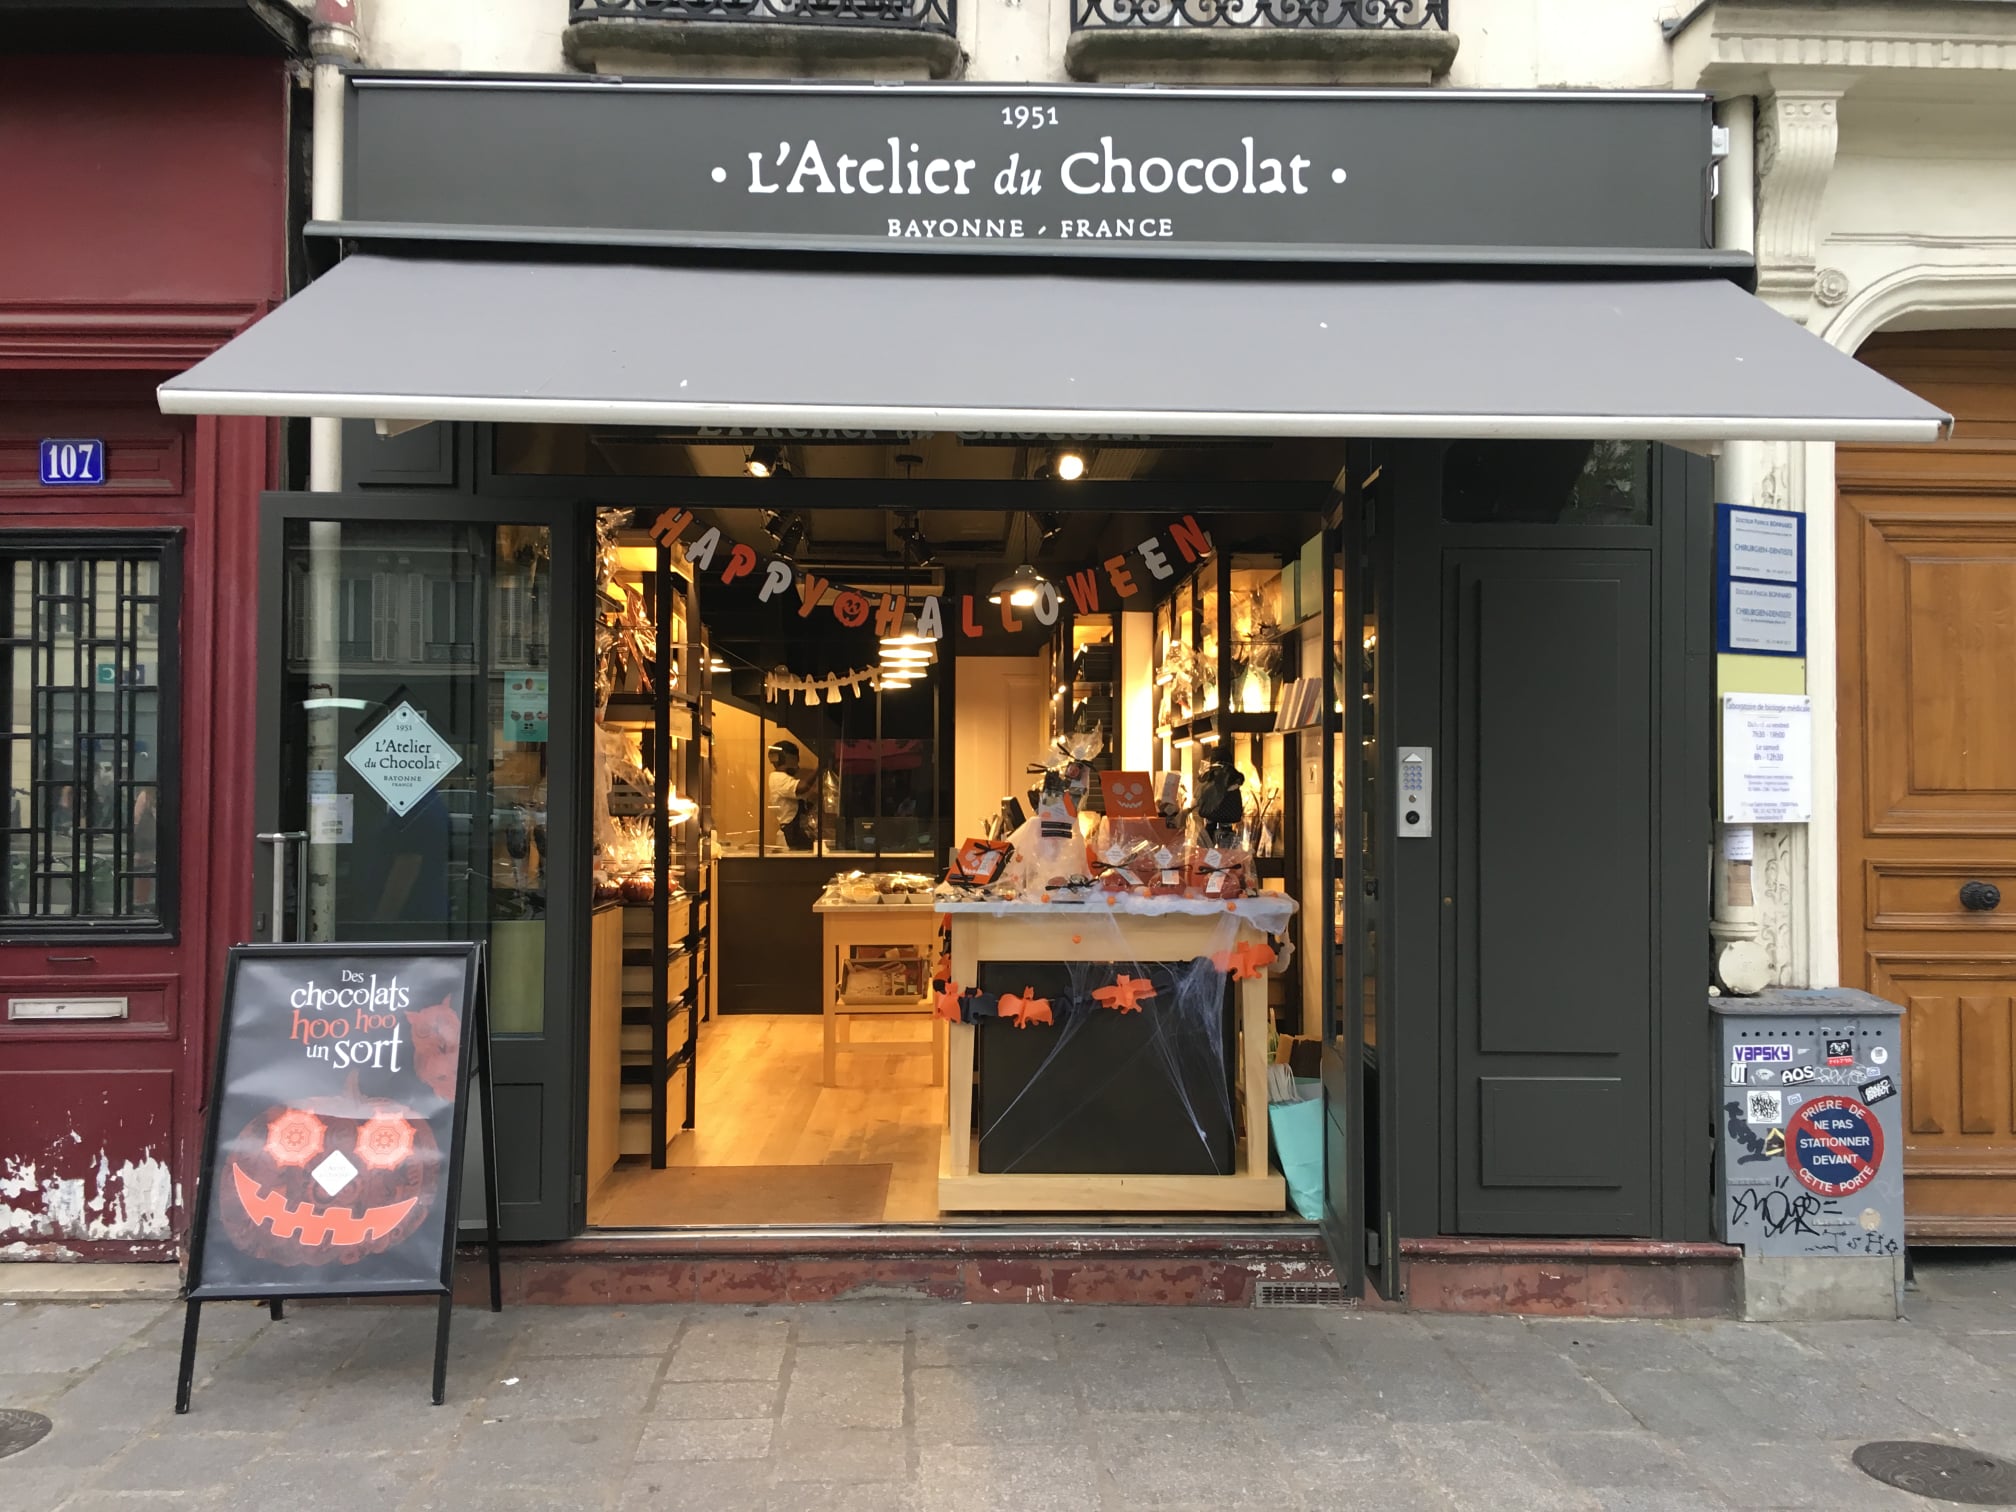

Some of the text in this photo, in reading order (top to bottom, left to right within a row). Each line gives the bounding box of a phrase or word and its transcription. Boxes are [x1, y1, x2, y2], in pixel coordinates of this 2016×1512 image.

[1001, 106, 1059, 129] 1951
[747, 136, 1311, 196] L'Atelier du Chocolat
[887, 218, 1174, 238] BAYONNE FRANCE
[48, 444, 94, 479] 107
[649, 507, 1213, 640] HAPPY HALLOWEEN
[375, 739, 432, 754] L'Atelier
[364, 755, 442, 770] du Chocolat
[341, 969, 365, 984] Des
[290, 973, 411, 1012] chocolats
[289, 1007, 397, 1046] hoo hoo
[306, 1021, 403, 1073] un sort
[1781, 1066, 1814, 1083] AOS
[1801, 1099, 1843, 1122] PRIERE
[1848, 1103, 1867, 1120] DE
[1814, 1119, 1854, 1130] NE PAS
[1799, 1136, 1870, 1149] STATIONNER
[1812, 1153, 1859, 1166] DEVANT
[1799, 1165, 1874, 1193] CETTE PORTE
